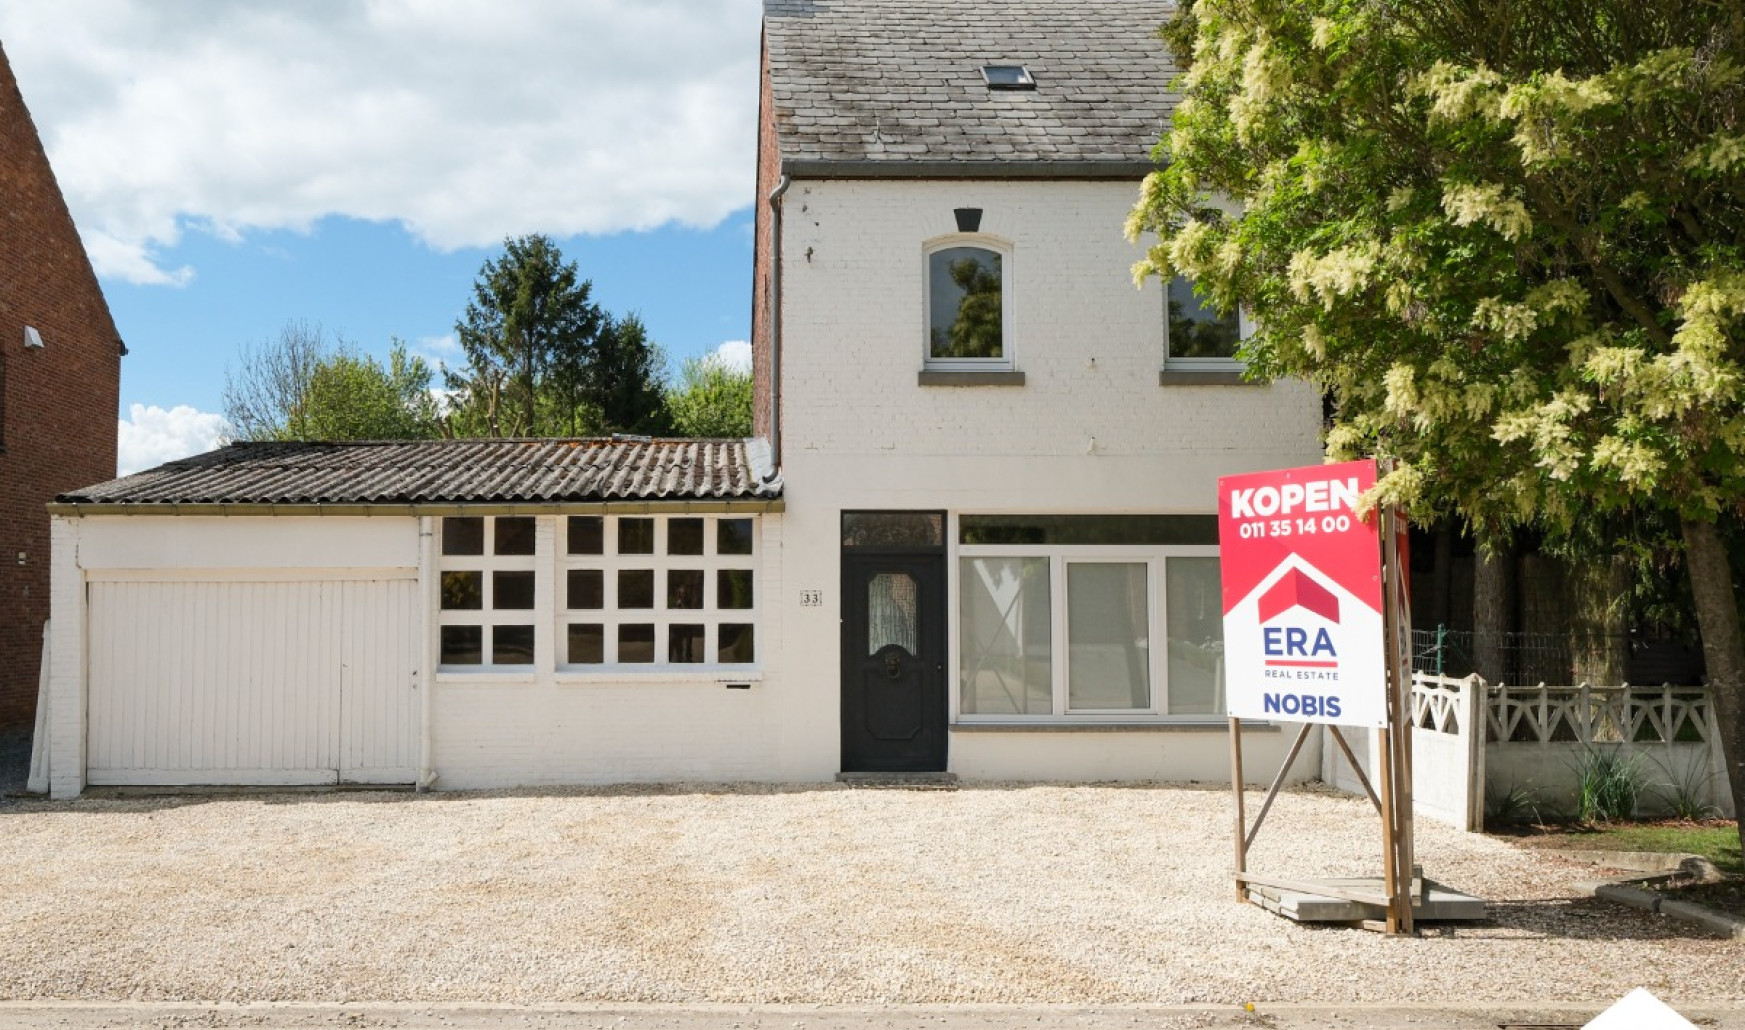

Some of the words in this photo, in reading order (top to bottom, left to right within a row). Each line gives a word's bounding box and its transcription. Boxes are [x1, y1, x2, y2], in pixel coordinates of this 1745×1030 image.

[1231, 477, 1359, 519] KOPEN
[1240, 521, 1265, 539] 011
[1270, 519, 1292, 537] 35
[1296, 517, 1317, 535] 14
[1321, 515, 1350, 533] 00
[804, 594, 818, 604] 33
[1263, 627, 1337, 657] ERA
[1265, 669, 1292, 679] REAL
[1297, 671, 1339, 681] ESTATE
[1264, 692, 1342, 718] NOBIS
